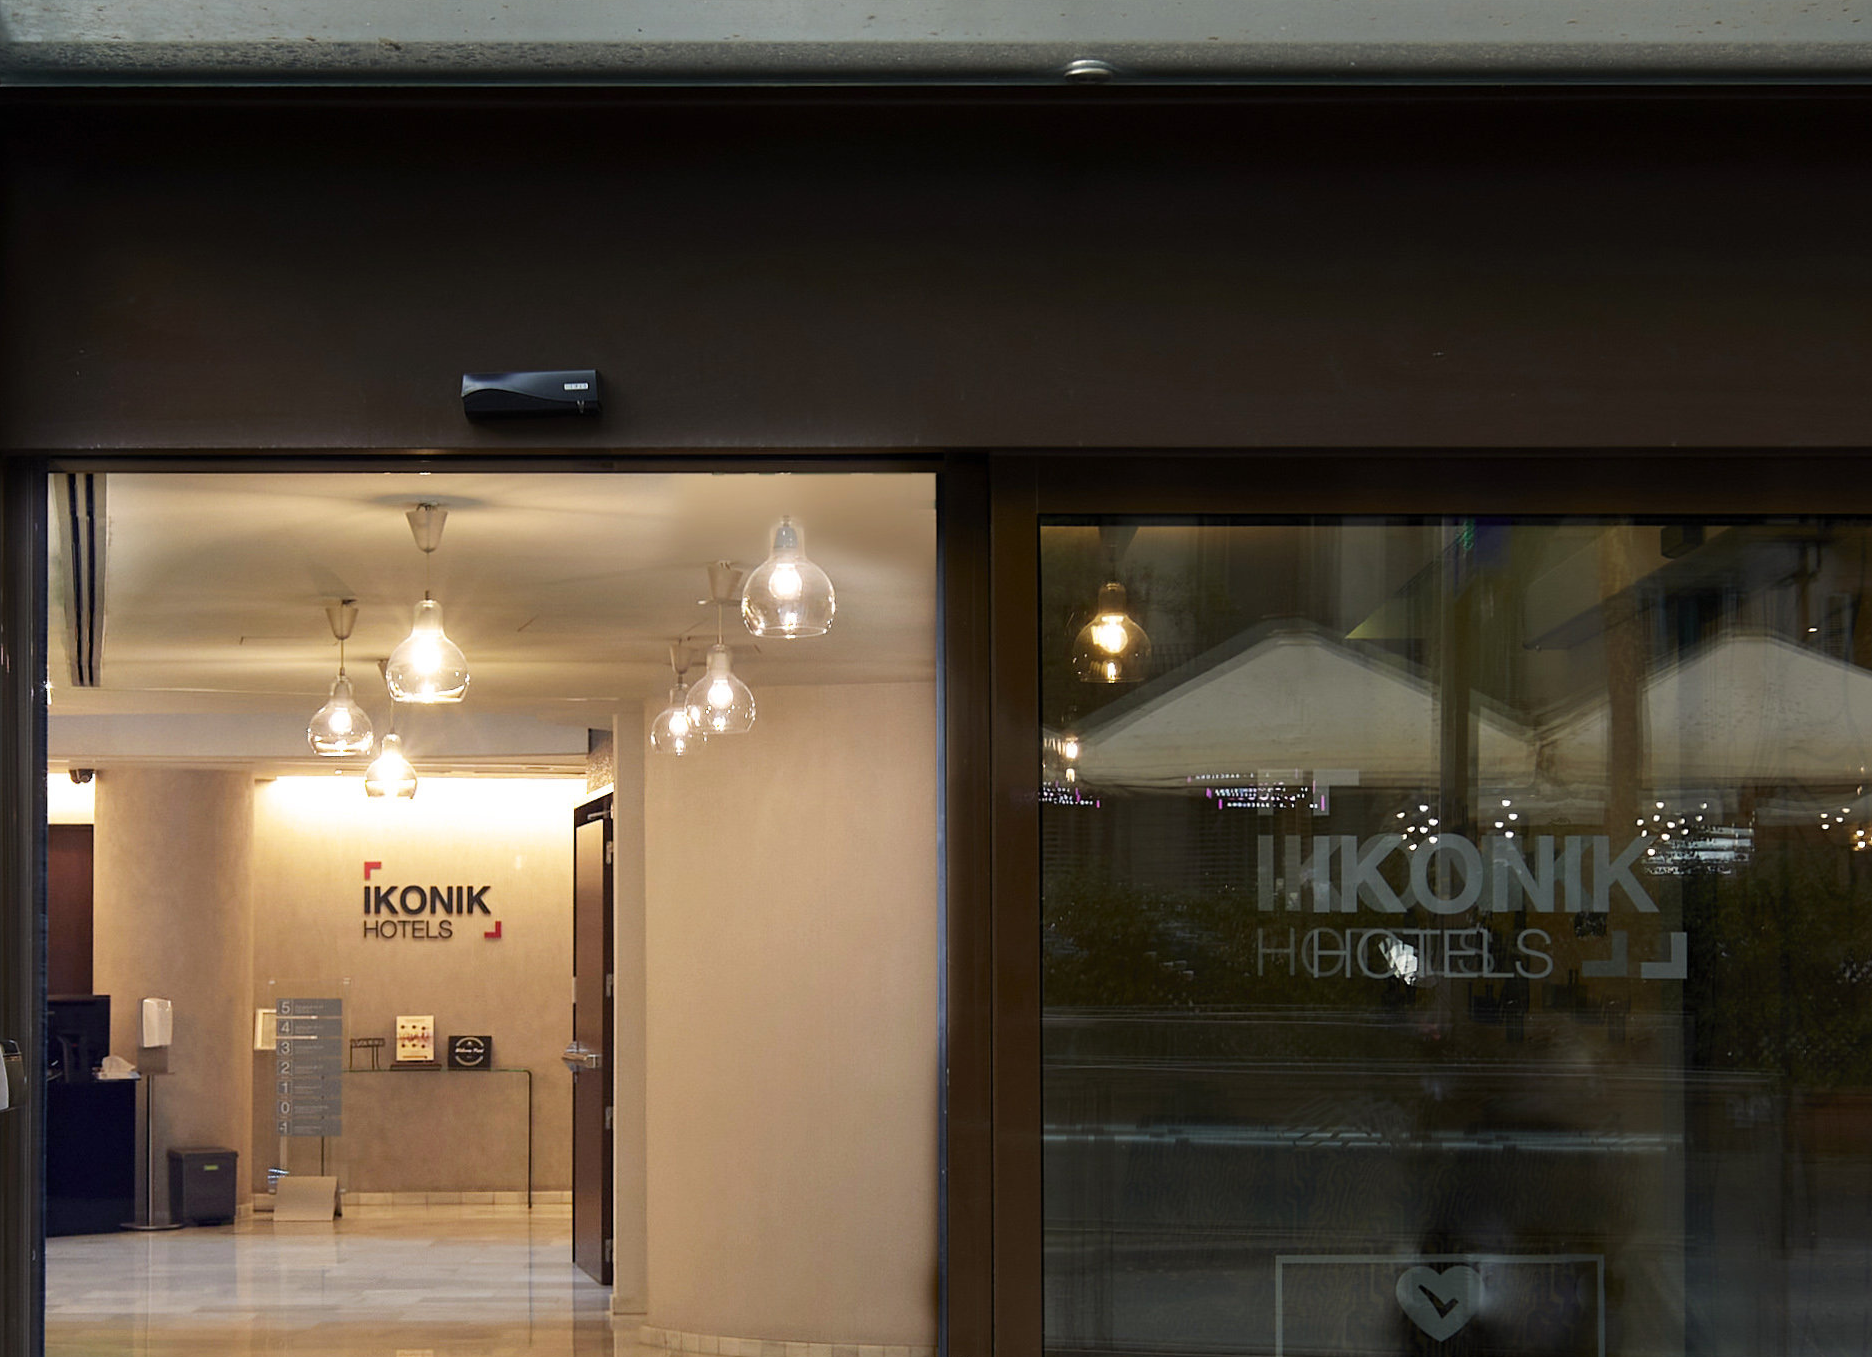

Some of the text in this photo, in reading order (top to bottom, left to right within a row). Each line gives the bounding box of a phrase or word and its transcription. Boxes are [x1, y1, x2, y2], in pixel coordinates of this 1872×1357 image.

[364, 885, 492, 915] IKONIK
[364, 919, 454, 939] HOTELS
[281, 1001, 290, 1015] 5
[281, 1021, 290, 1034] 4
[281, 1041, 290, 1054] 3
[281, 1061, 290, 1074] 2
[282, 1082, 288, 1094] 1
[281, 1101, 290, 1114] 0
